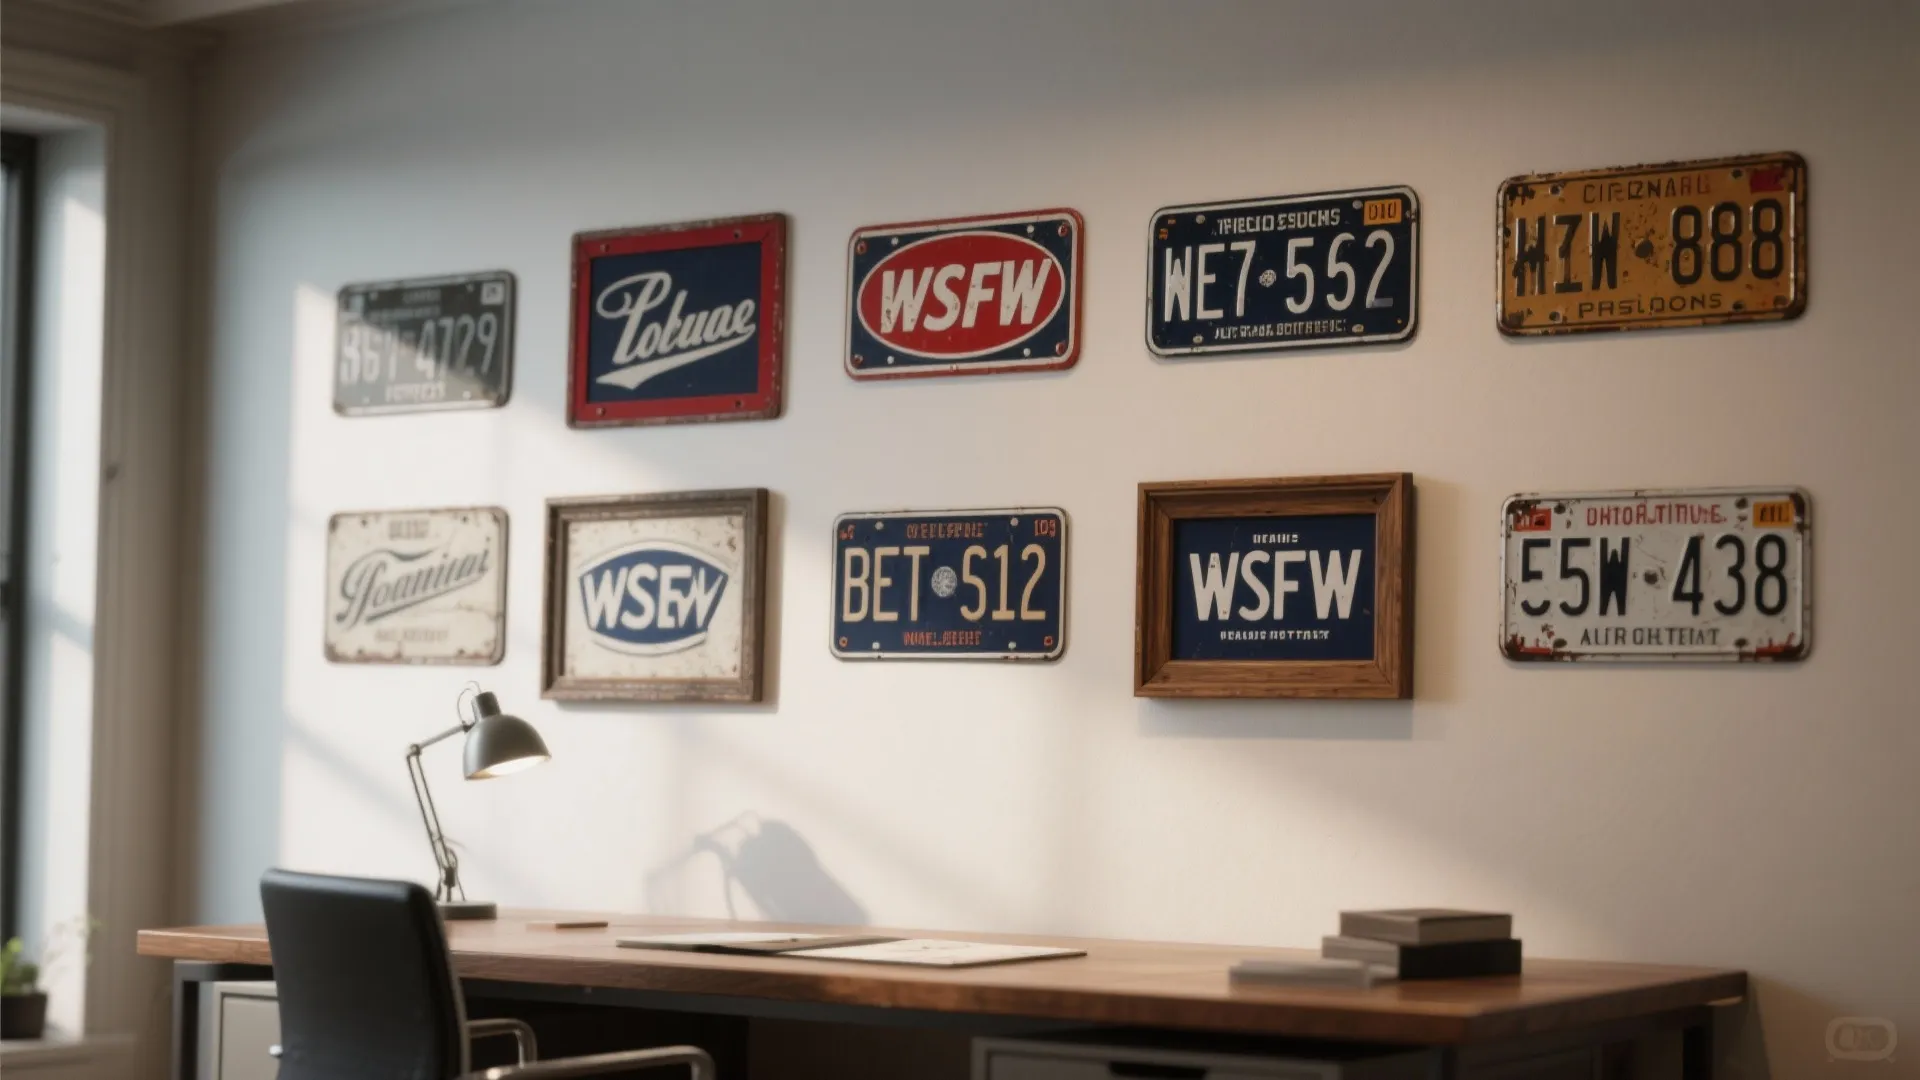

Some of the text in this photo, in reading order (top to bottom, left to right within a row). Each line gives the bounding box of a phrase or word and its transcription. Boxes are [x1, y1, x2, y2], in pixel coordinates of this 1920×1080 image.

[1164, 239, 1257, 323] WE7
[1670, 198, 1784, 286] 888
[880, 258, 1052, 334] WSFW
[842, 545, 930, 623] BET
[1189, 548, 1363, 622] WSFW
[1672, 533, 1788, 617] 438
